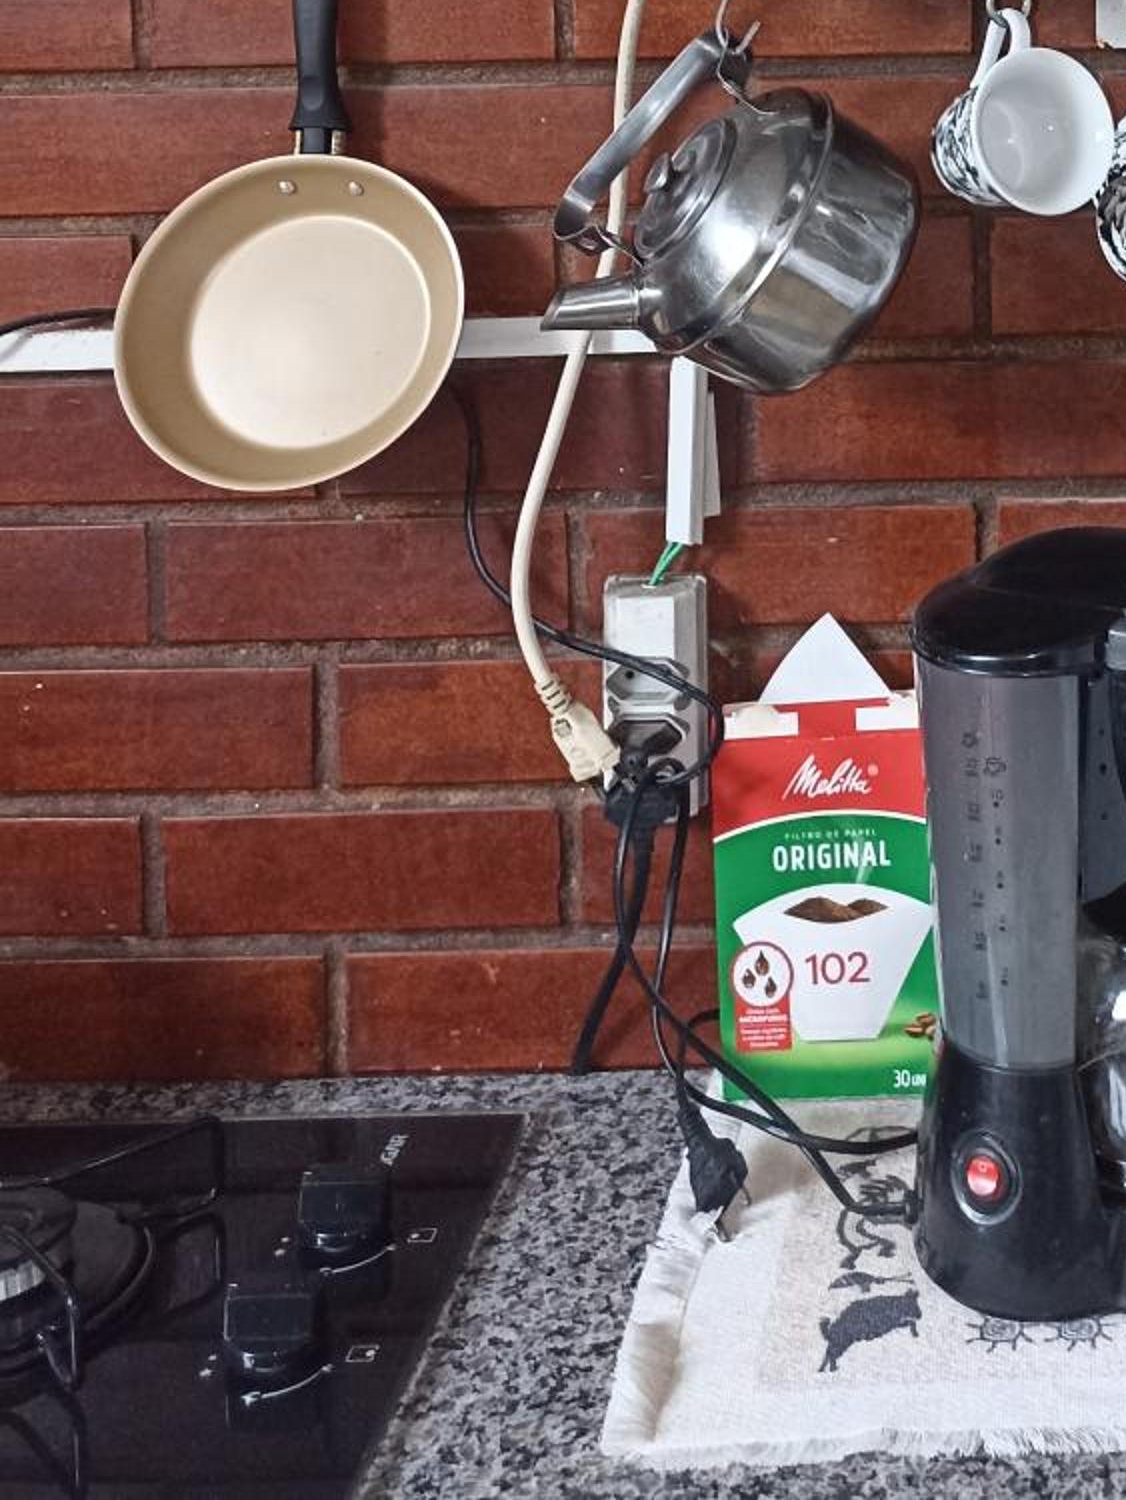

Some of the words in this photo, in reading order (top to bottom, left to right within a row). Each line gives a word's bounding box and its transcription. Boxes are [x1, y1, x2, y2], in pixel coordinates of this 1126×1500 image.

[781, 753, 872, 800] Melitta
[773, 840, 891, 872] ORIGINAL
[805, 951, 871, 985] 102
[893, 1069, 911, 1088] 30
